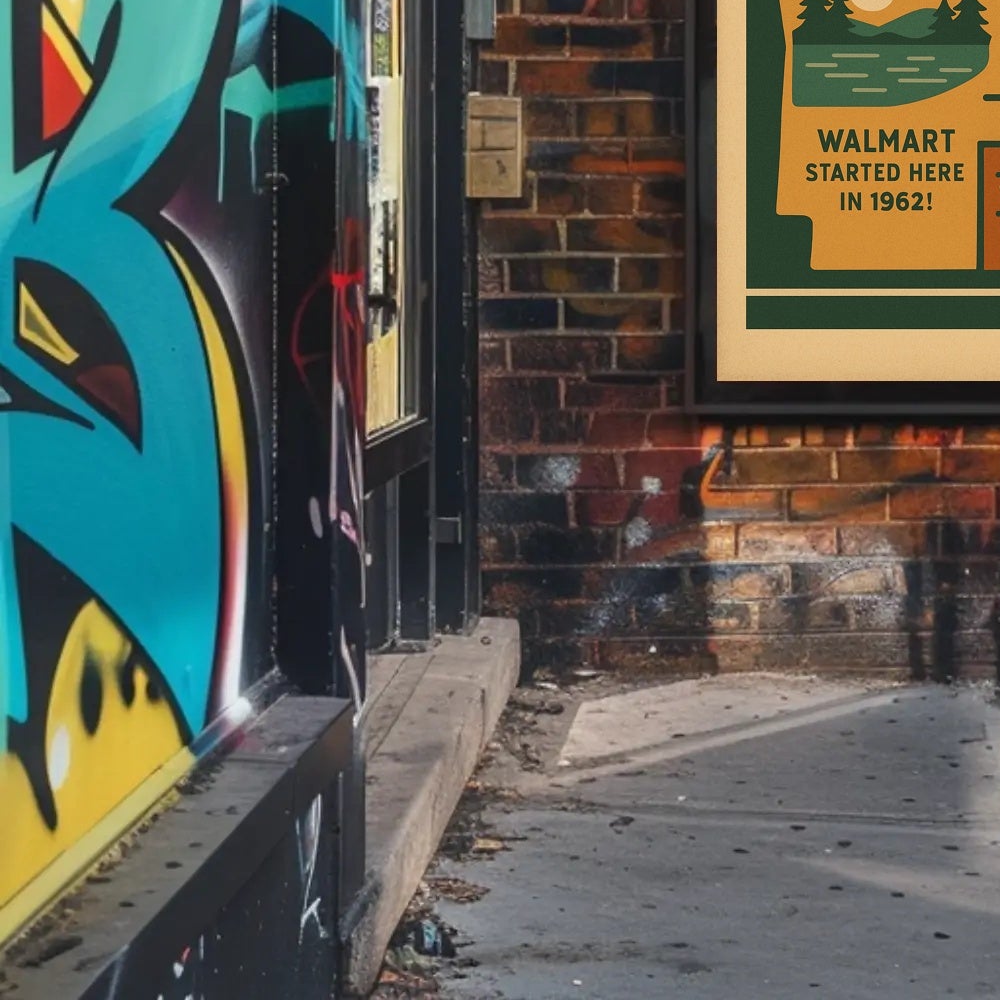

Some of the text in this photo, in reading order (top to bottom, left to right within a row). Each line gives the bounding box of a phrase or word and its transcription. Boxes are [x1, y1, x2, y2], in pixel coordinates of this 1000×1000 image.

[816, 128, 956, 153] WALMART
[805, 163, 965, 182] STARTED HERE
[840, 191, 933, 212] IN 1962!
